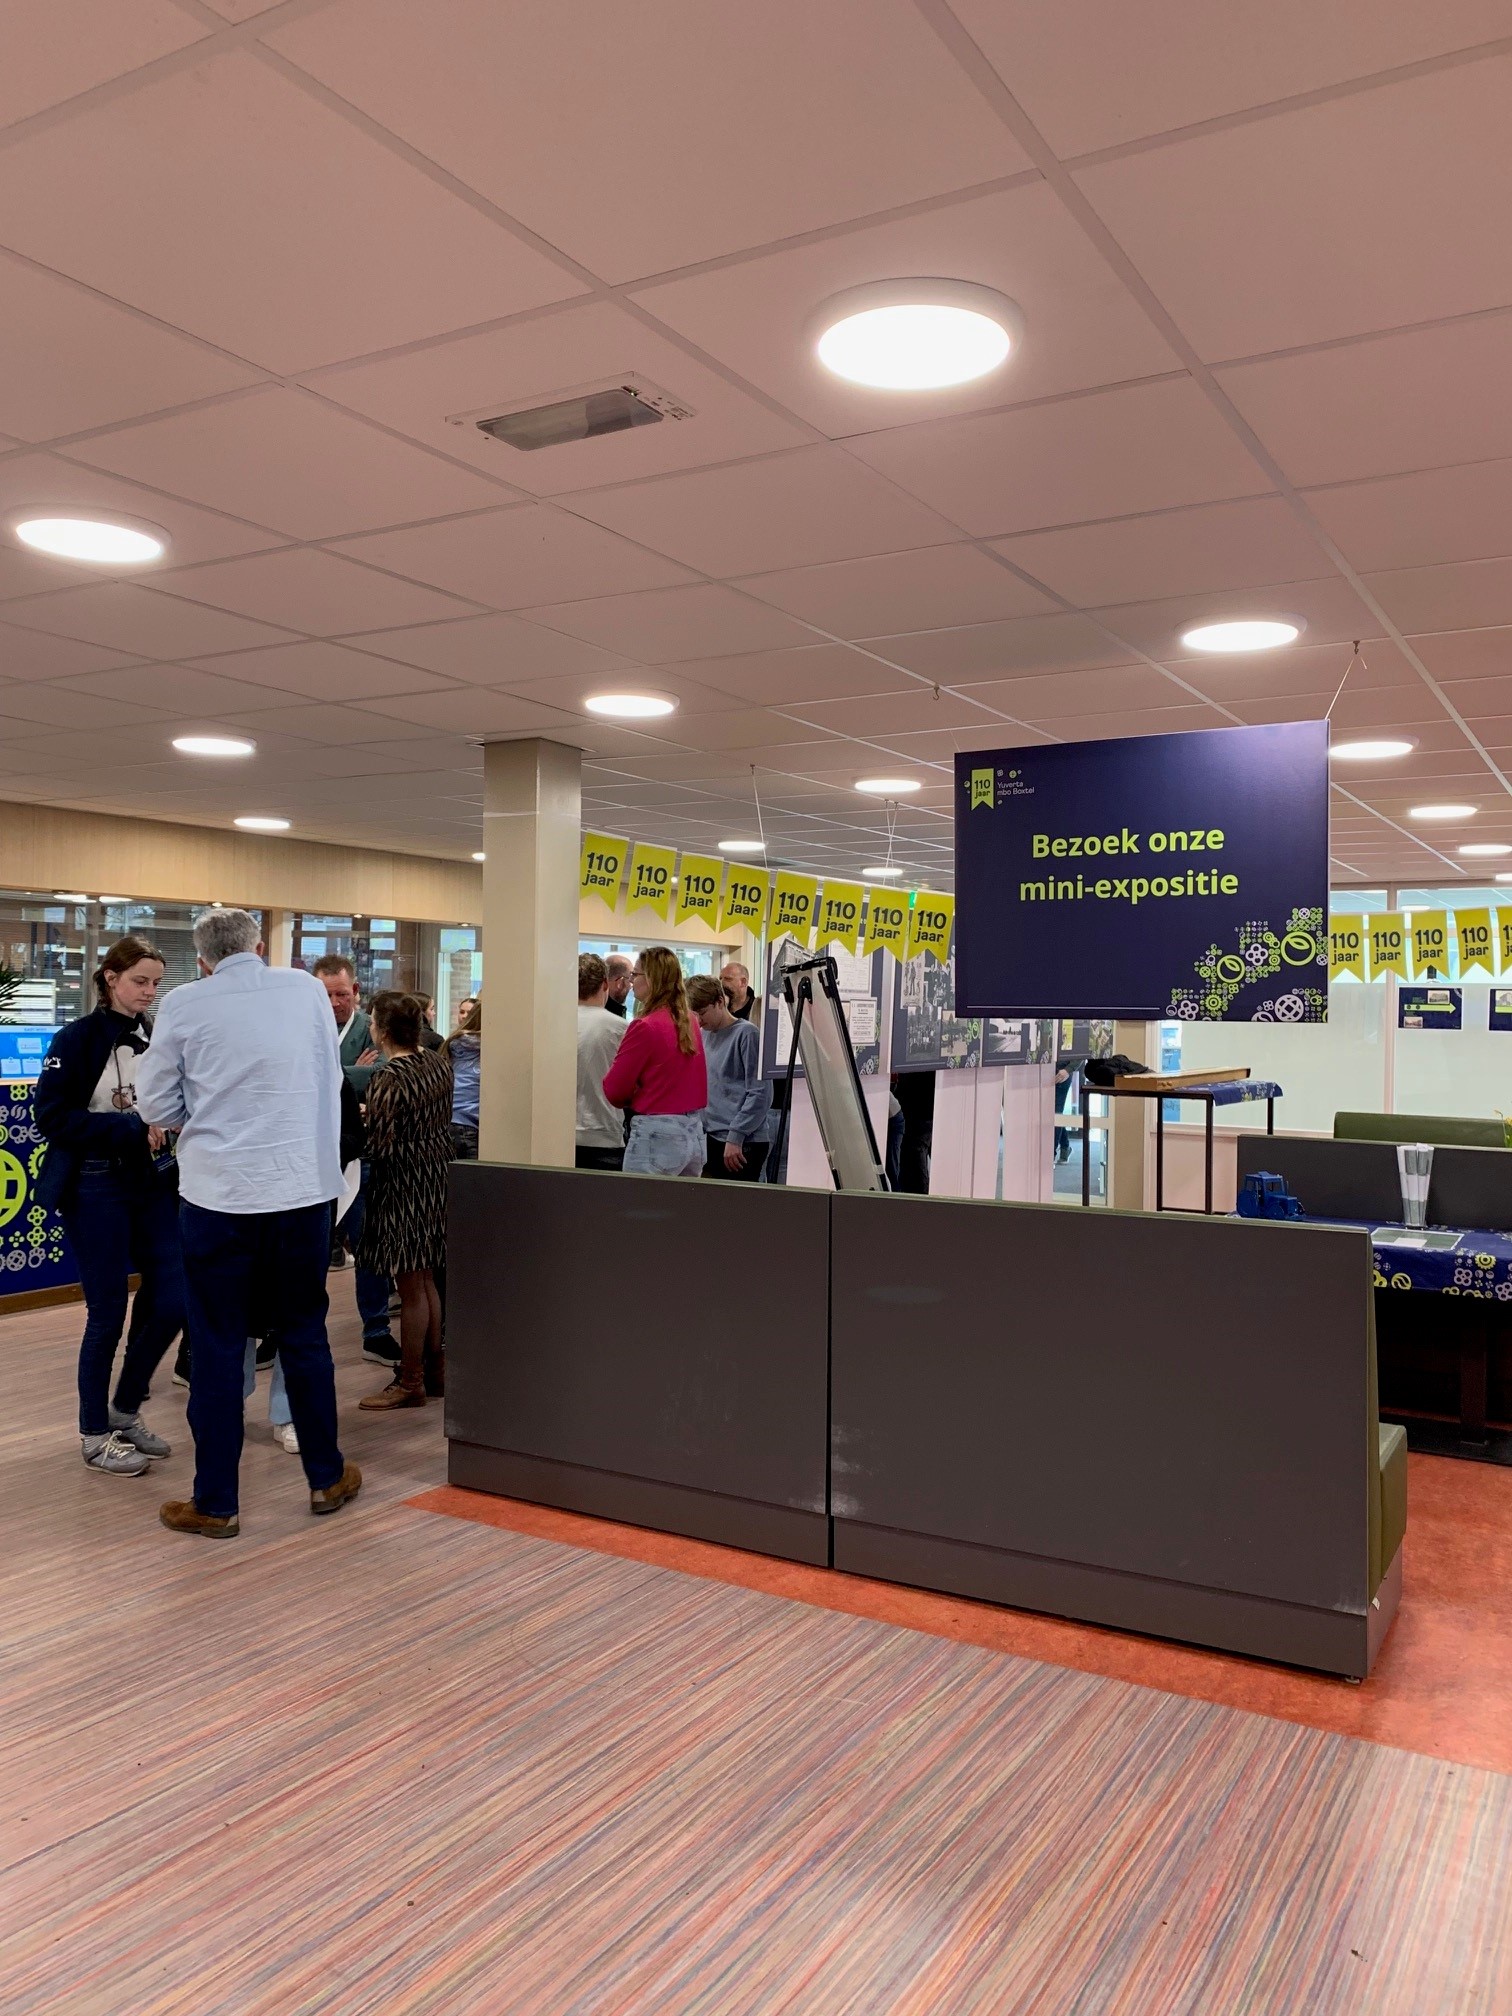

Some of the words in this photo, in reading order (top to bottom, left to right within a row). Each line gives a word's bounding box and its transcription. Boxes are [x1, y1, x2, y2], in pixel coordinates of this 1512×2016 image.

[974, 779, 991, 789] 110
[1013, 787, 1035, 795] Boxtel
[974, 790, 991, 799] jaar
[1032, 828, 1141, 859] Bezoek
[1149, 828, 1225, 853] onze
[586, 852, 618, 874] 110
[582, 870, 614, 887] jaar
[636, 864, 668, 885] 110
[633, 882, 665, 898] jaar
[684, 874, 715, 895] 110
[731, 882, 762, 903] 110
[1019, 868, 1239, 905] mini-expositie
[681, 893, 713, 908] jaar
[727, 900, 759, 917] jaar
[778, 892, 809, 912] 110
[775, 909, 806, 926] jaar
[826, 900, 856, 920] 110
[872, 906, 903, 927] 110
[822, 918, 853, 934] jaar
[917, 909, 947, 930] 110
[869, 924, 900, 940] jaar
[914, 929, 944, 943] jaar
[1330, 932, 1359, 949] 110
[1373, 931, 1401, 948] 110
[1415, 928, 1443, 946] 110
[1461, 926, 1488, 943] 110
[1331, 950, 1360, 966] jaar
[1374, 949, 1401, 965] jaar
[1417, 947, 1444, 963] jaar
[1463, 944, 1489, 960] jaar
